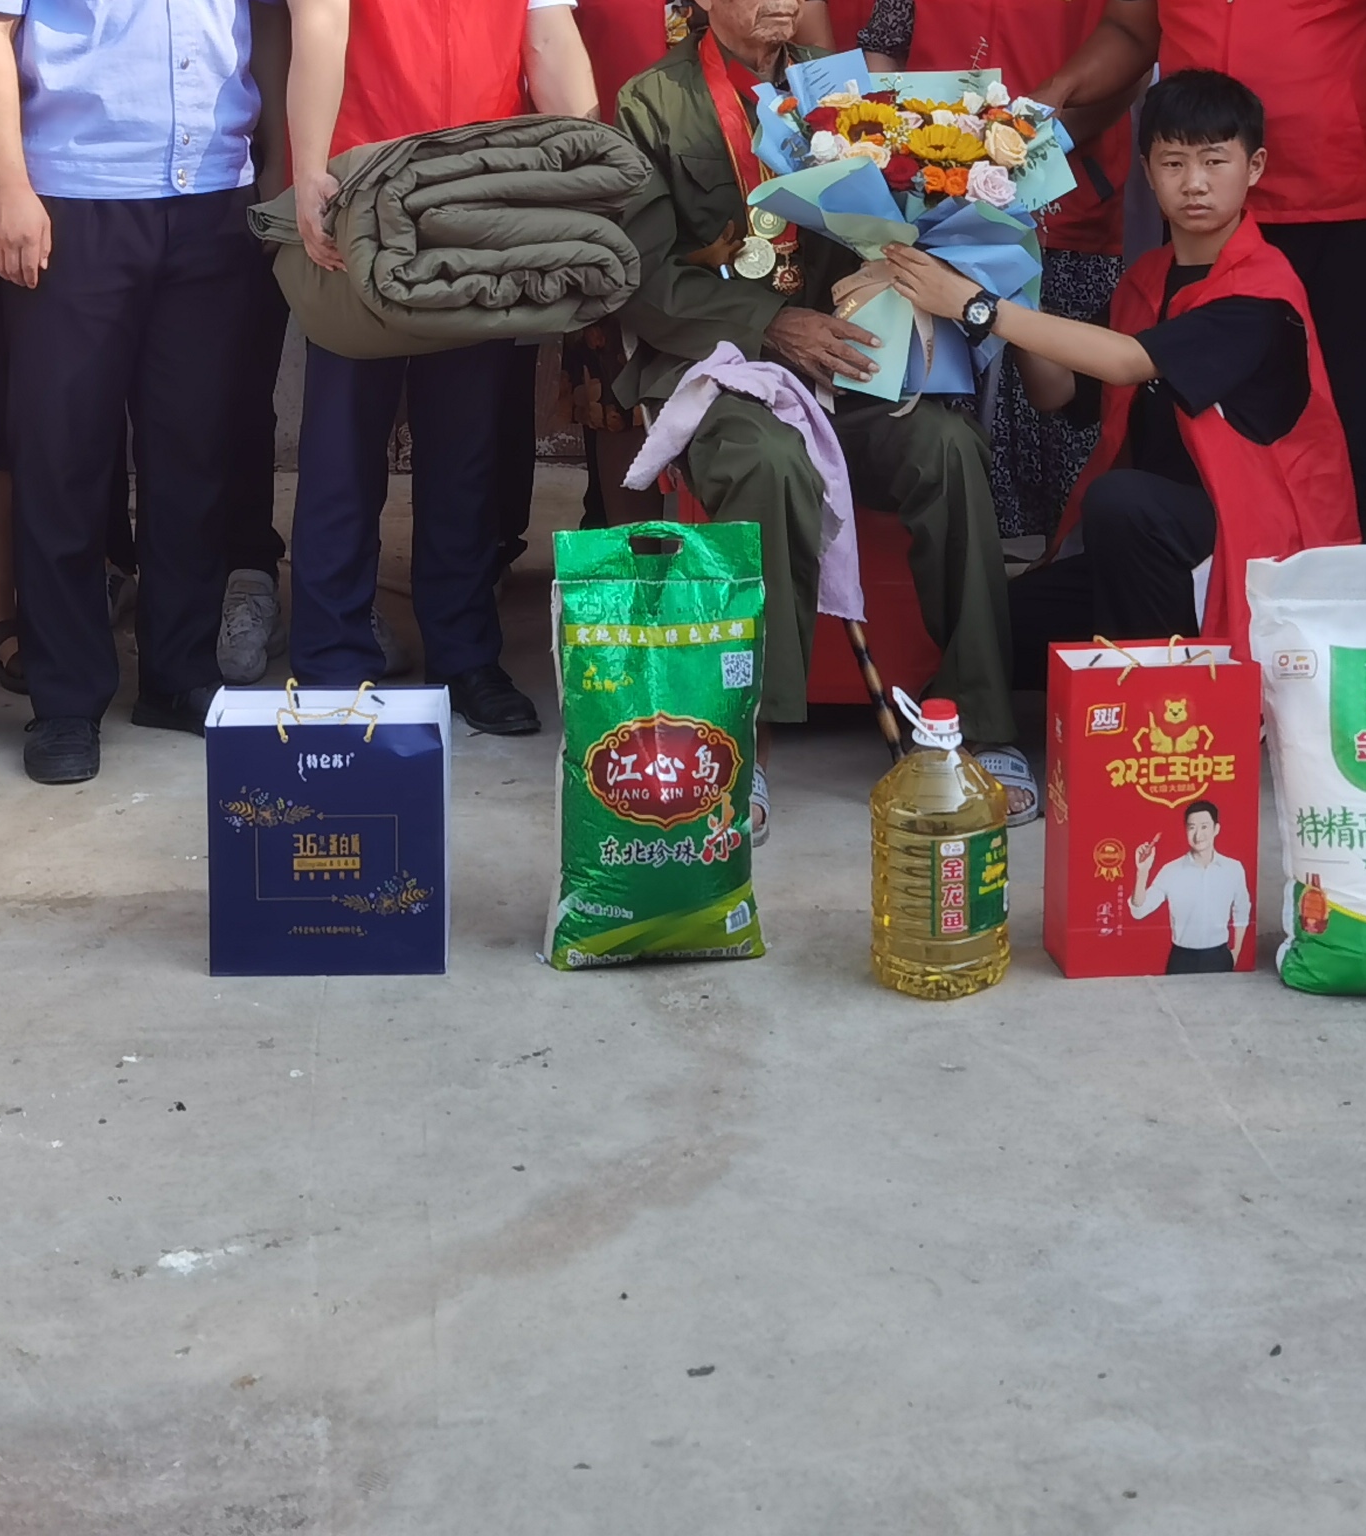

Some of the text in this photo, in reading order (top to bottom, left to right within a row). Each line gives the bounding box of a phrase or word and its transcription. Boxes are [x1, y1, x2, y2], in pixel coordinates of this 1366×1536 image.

[606, 744, 721, 787] 江心岛
[1106, 753, 1236, 787] 双汇王中王
[607, 787, 650, 801] JIANG
[660, 787, 684, 800] XIN
[941, 859, 965, 933] 金龙鱼
